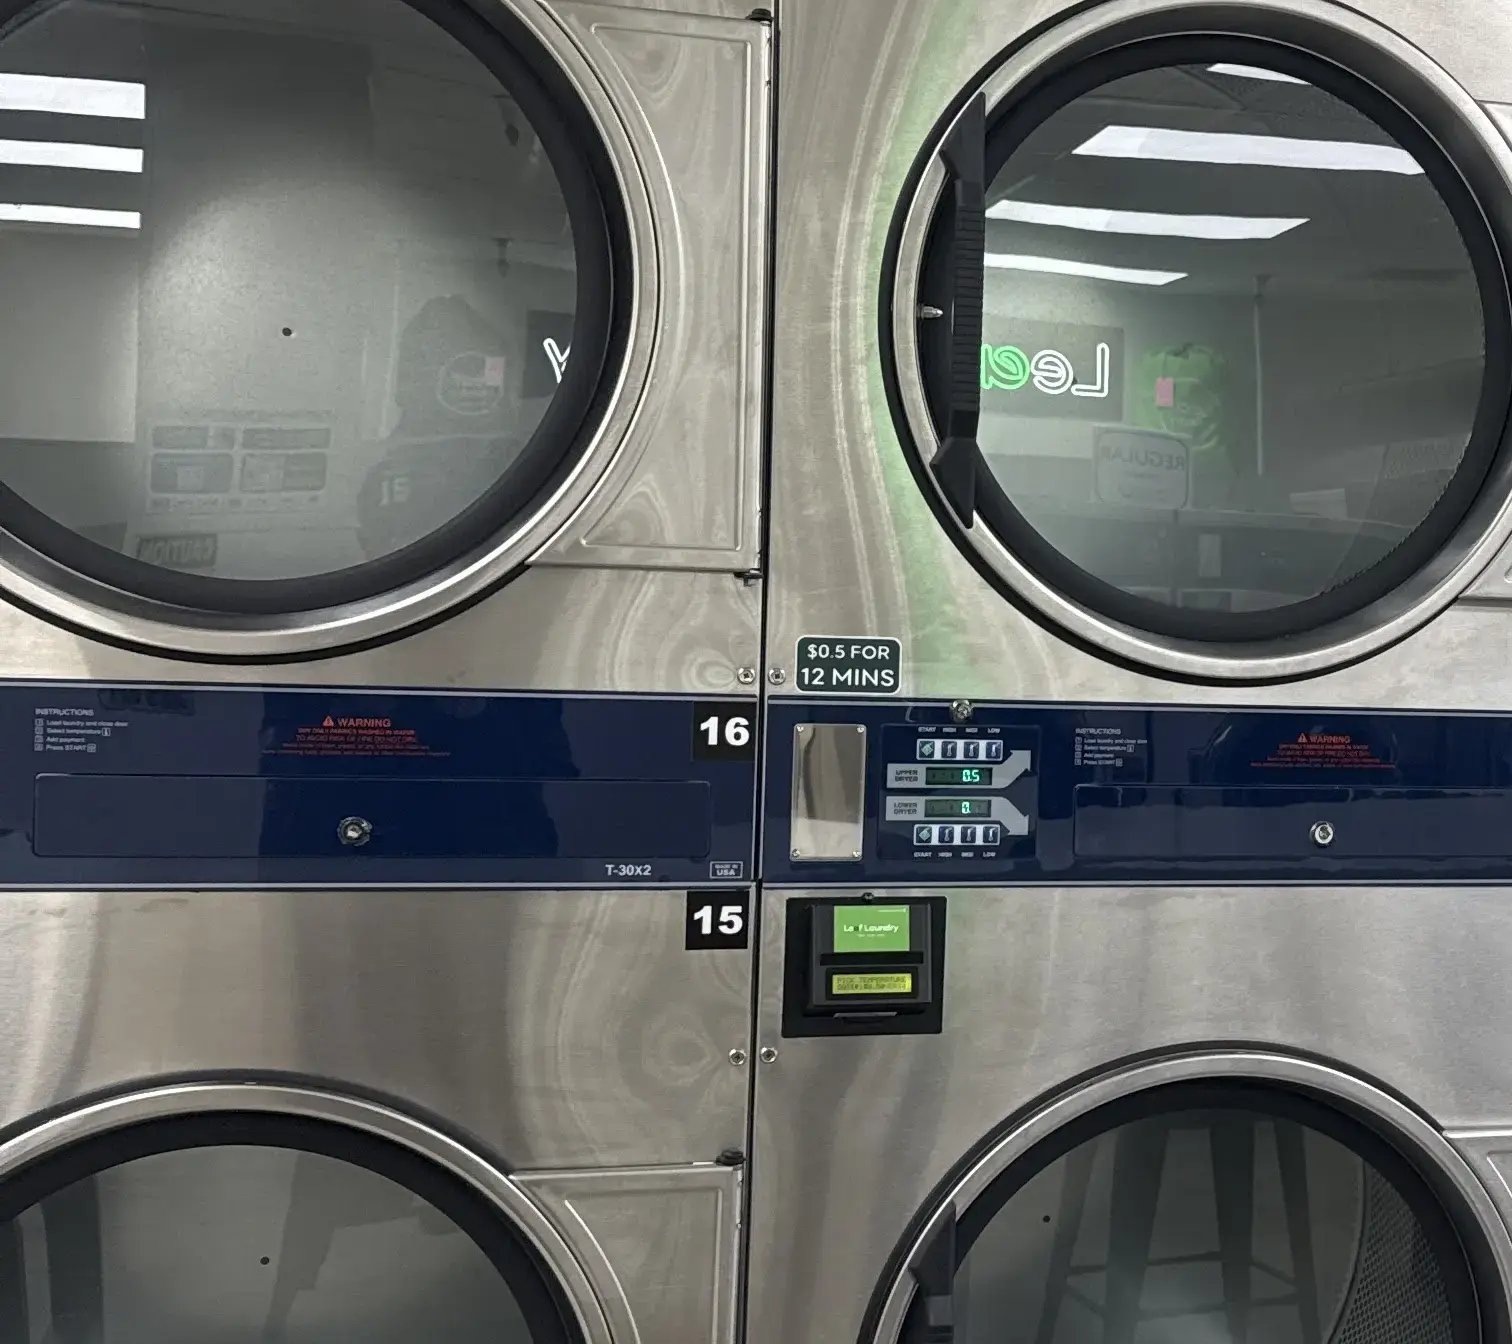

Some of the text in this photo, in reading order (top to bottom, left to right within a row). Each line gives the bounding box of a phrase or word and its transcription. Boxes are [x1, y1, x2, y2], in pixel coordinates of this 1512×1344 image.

[807, 644, 890, 660] $0.5 FOR
[801, 668, 894, 687] 12 MINS
[35, 708, 94, 716] INSTRUCTIONS
[337, 719, 391, 727] WARNING
[700, 716, 750, 746] 16
[605, 864, 652, 876] T-30X2
[693, 905, 743, 934] 15
[864, 924, 899, 933] Laundry
